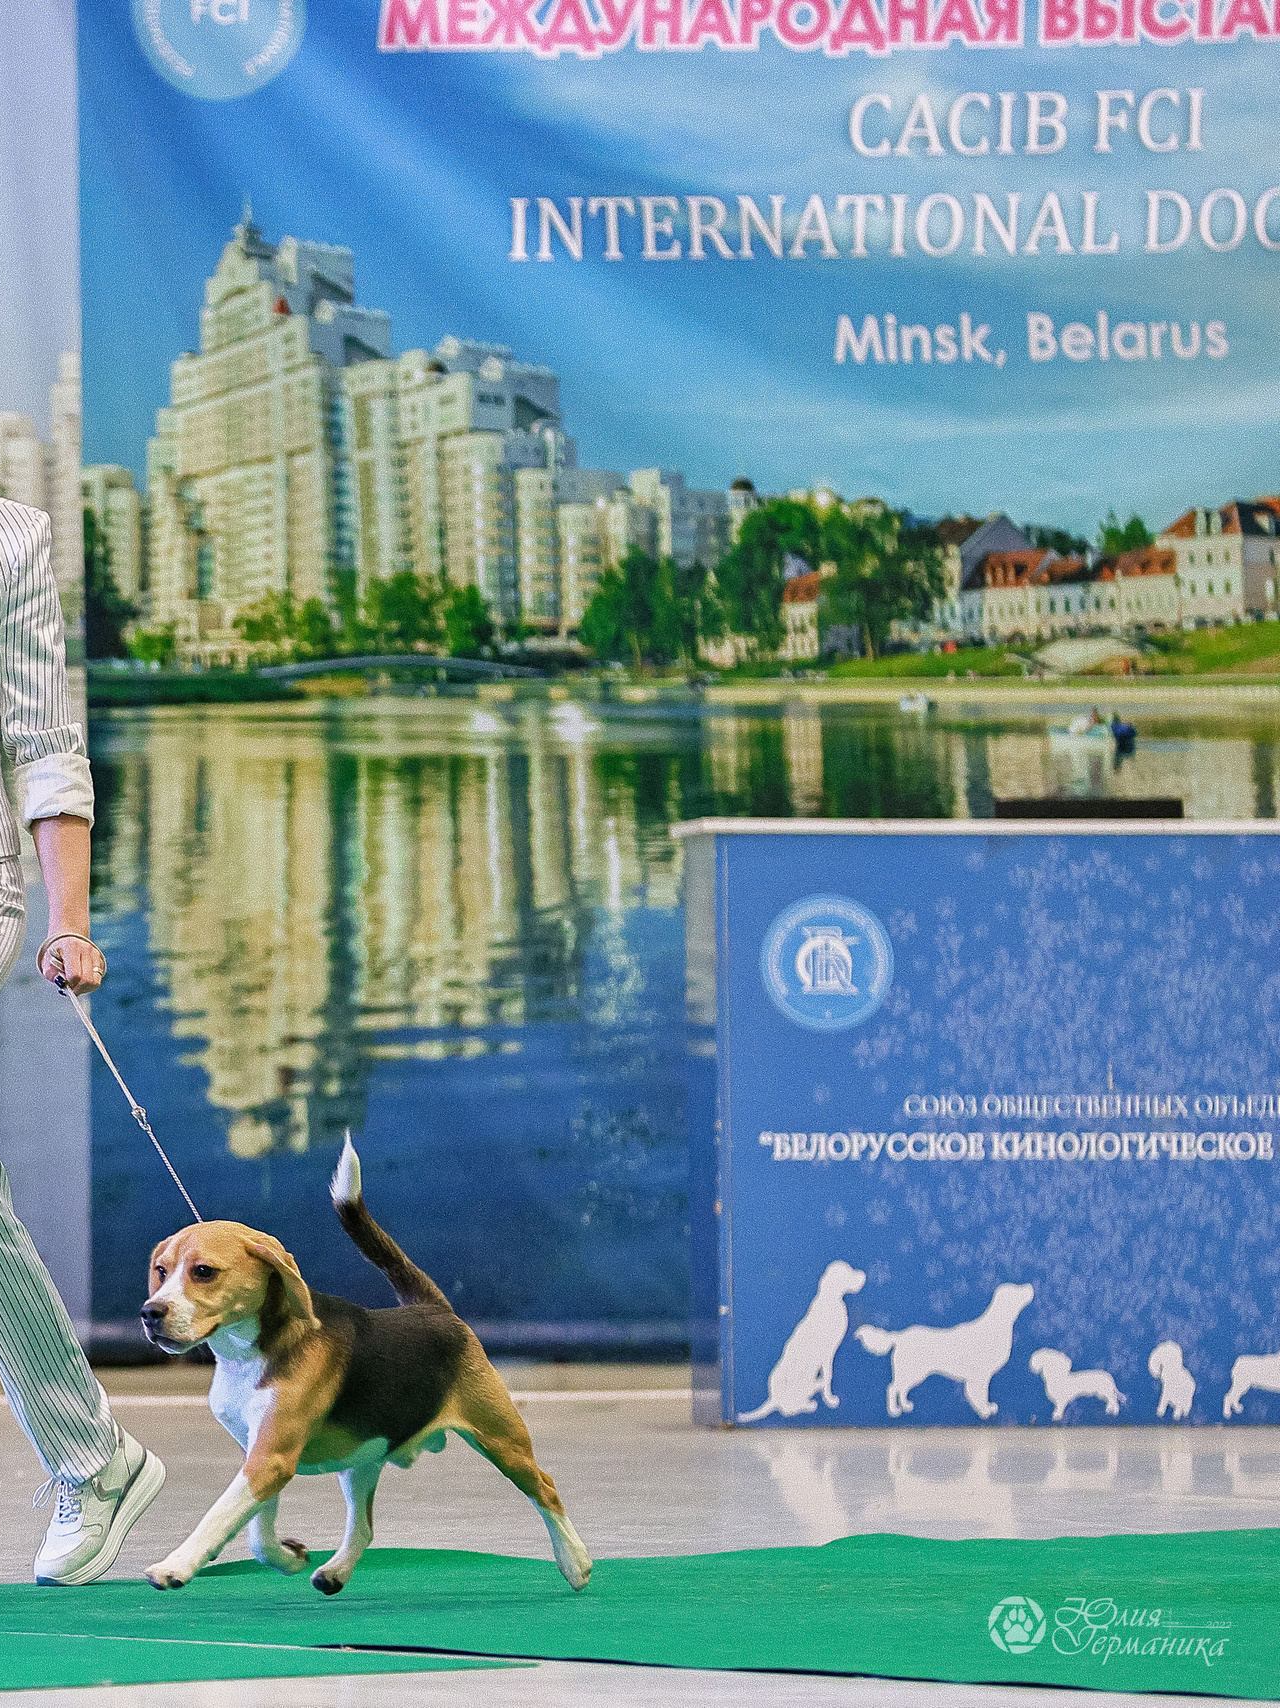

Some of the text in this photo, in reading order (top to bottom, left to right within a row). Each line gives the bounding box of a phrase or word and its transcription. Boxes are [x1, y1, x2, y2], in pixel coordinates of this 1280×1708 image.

[376, 0, 1280, 60] МЕЖДУНАРОДНАЯ ВЫСТА
[850, 87, 1207, 157] CACIB FCI
[508, 193, 1120, 262] INTERNATIONAL
[833, 310, 1230, 367] Minsk, Belarus
[903, 1094, 977, 1120] СОЮЗ
[990, 1131, 1274, 1161] КИНОЛОГИЧЕСКОЕ
